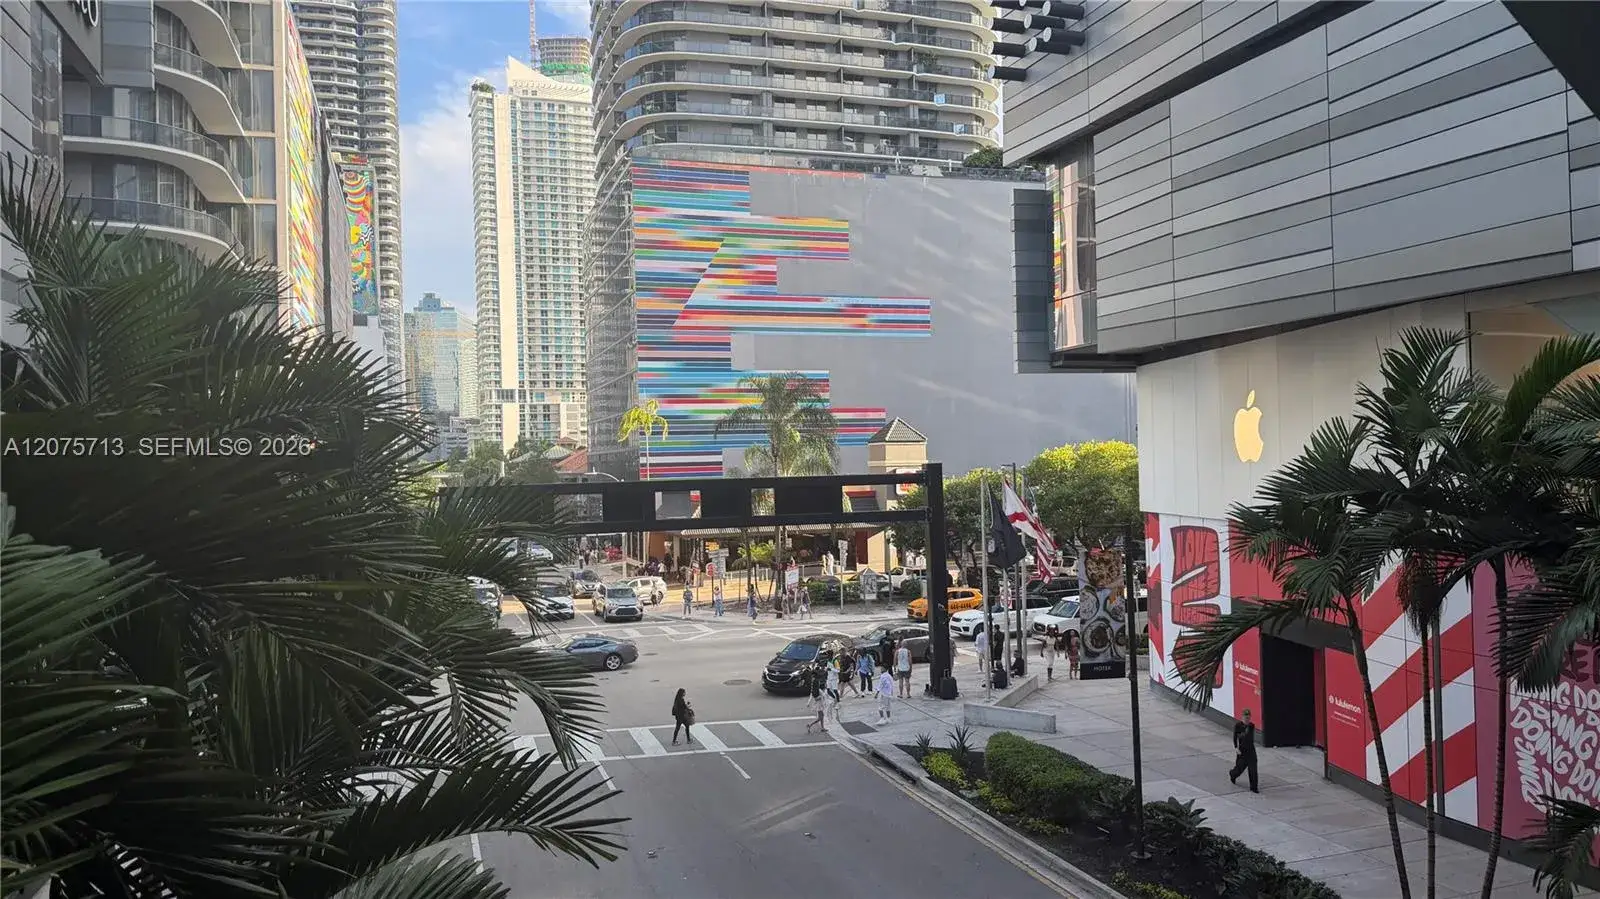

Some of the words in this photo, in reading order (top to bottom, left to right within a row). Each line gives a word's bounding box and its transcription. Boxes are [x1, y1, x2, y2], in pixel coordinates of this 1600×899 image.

[1335, 696, 1361, 714] lululemon
[1528, 700, 1597, 760] DOING
[1510, 706, 1573, 774] DOING
